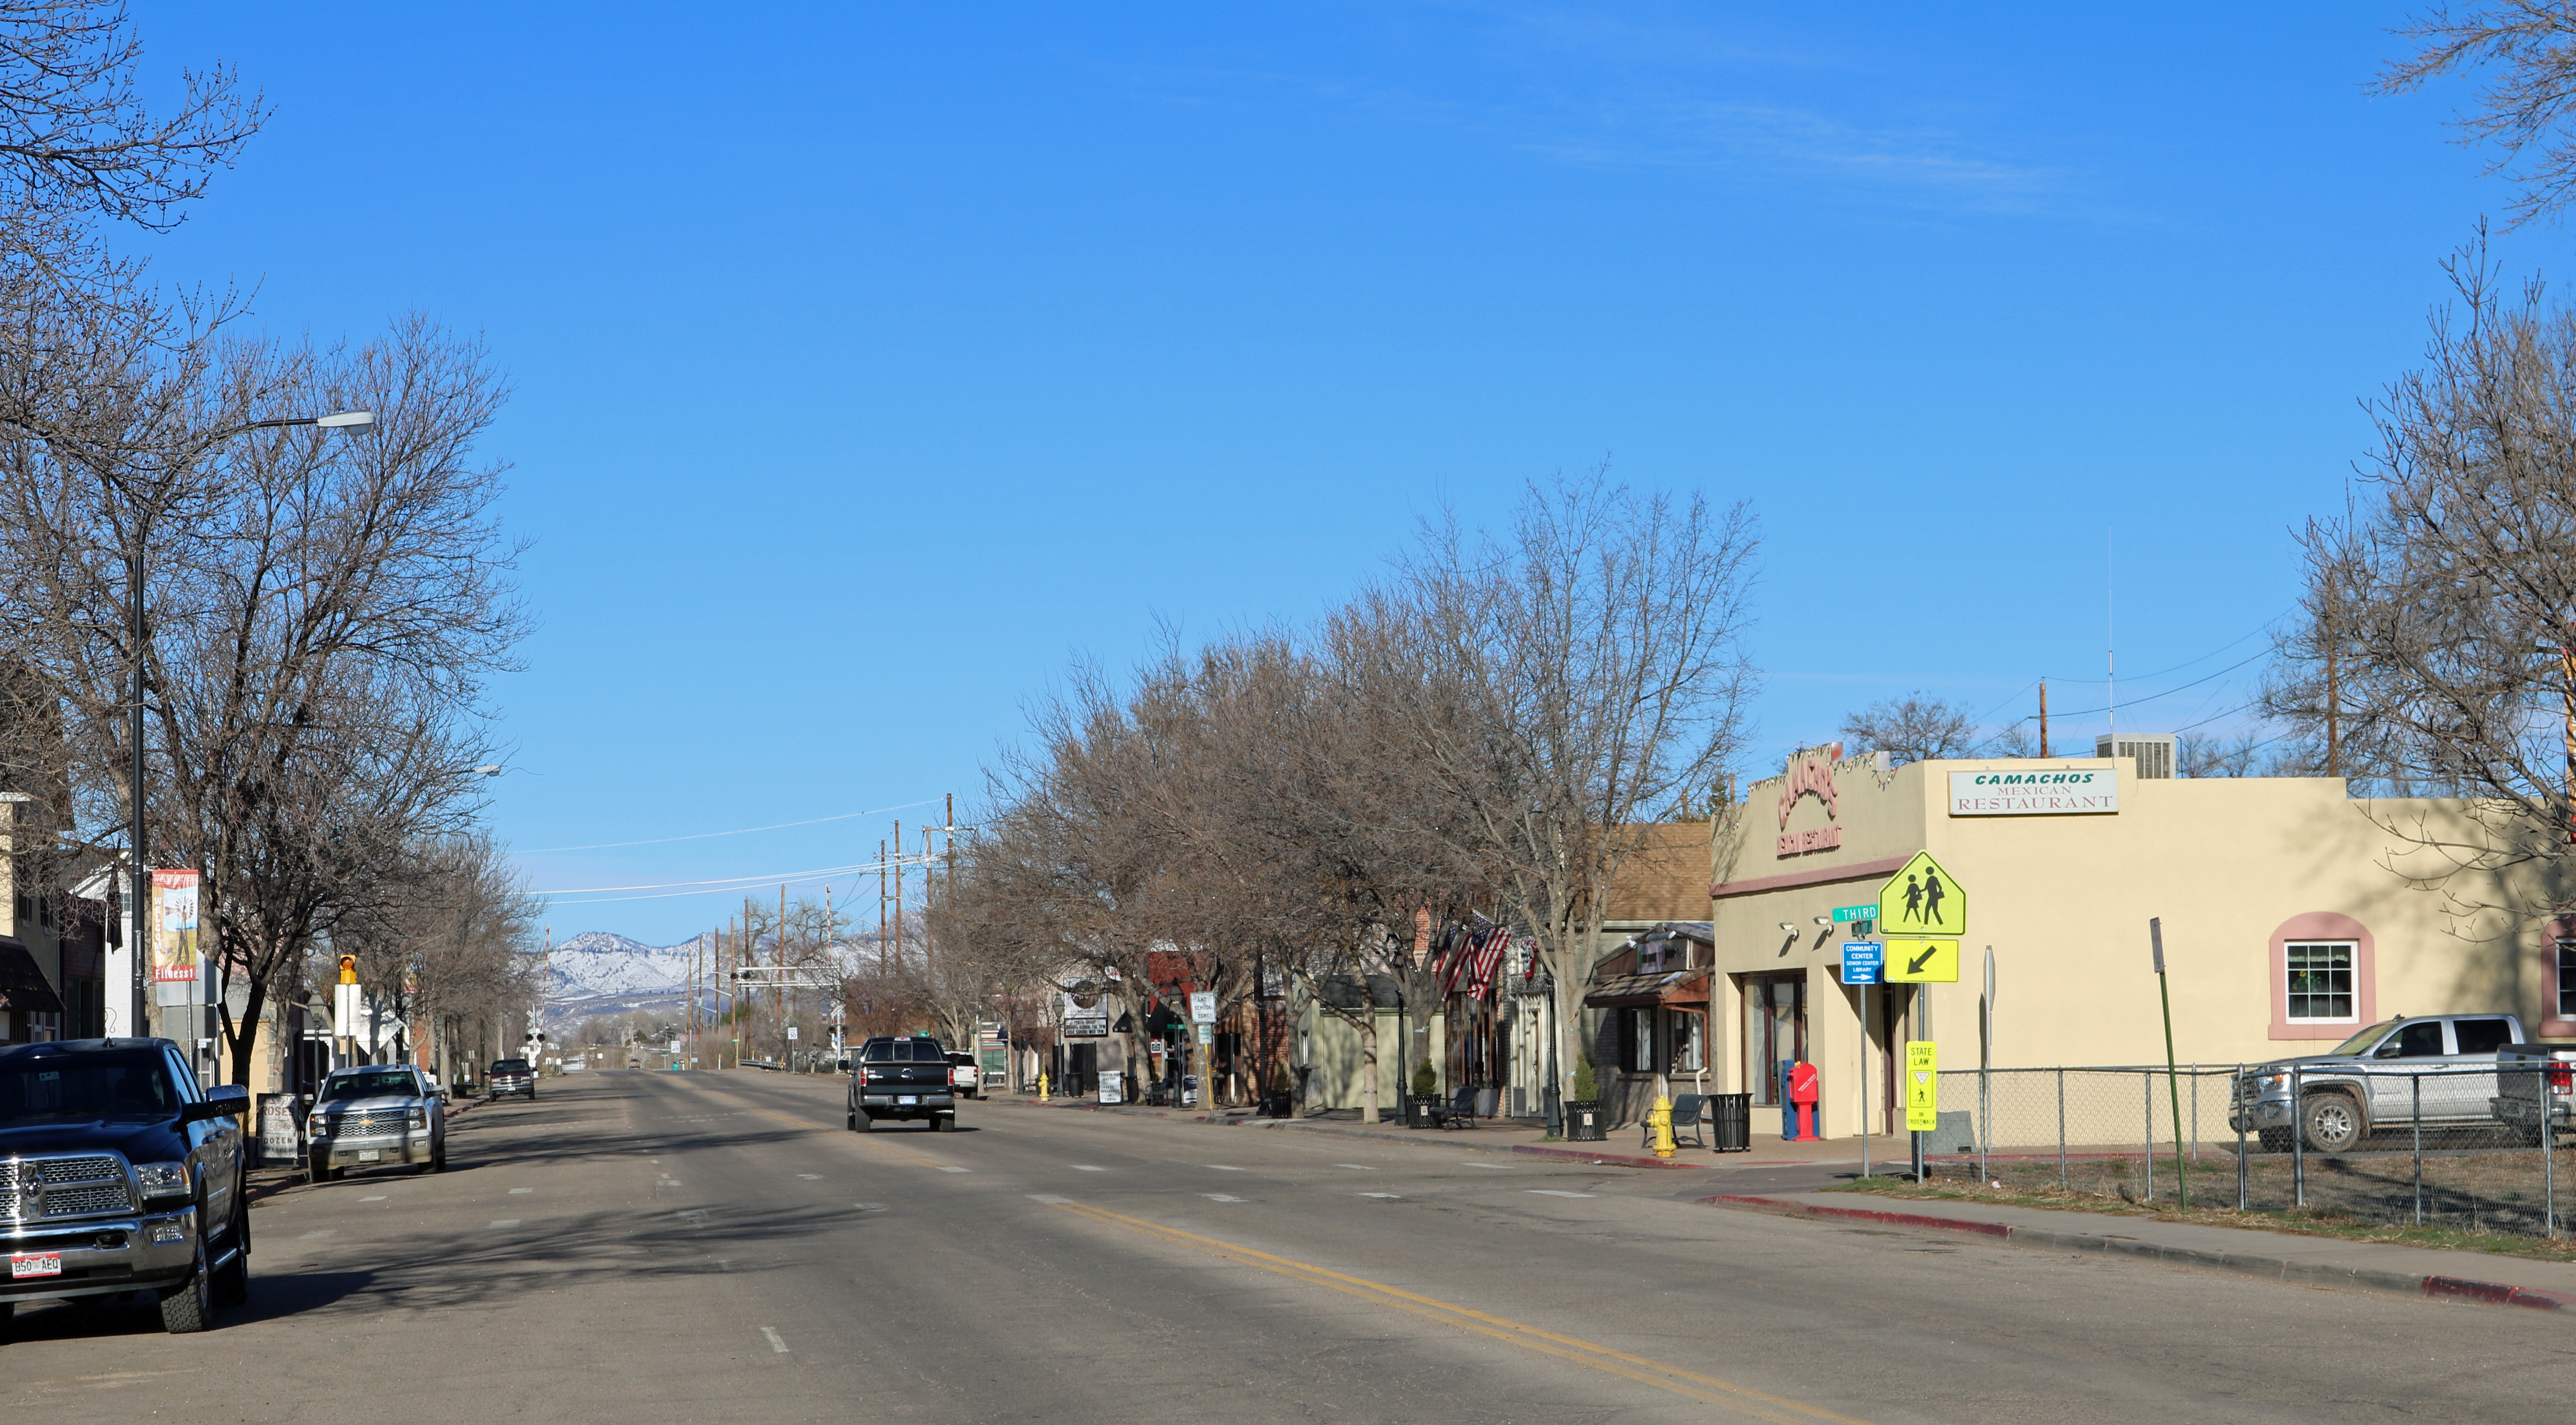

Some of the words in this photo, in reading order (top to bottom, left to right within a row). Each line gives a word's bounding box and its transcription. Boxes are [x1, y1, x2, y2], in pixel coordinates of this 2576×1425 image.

[1997, 786, 2072, 796] MEXICAN
[1957, 795, 2113, 810] RESTAURANT
[1777, 832, 1802, 856] MEXICAN
[1802, 824, 1842, 852] RESTAURANT
[1843, 907, 1876, 920] THIRD
[154, 897, 162, 959] WELCOME
[261, 1106, 295, 1116] ROSES
[42, 1259, 58, 1270] AEQ
